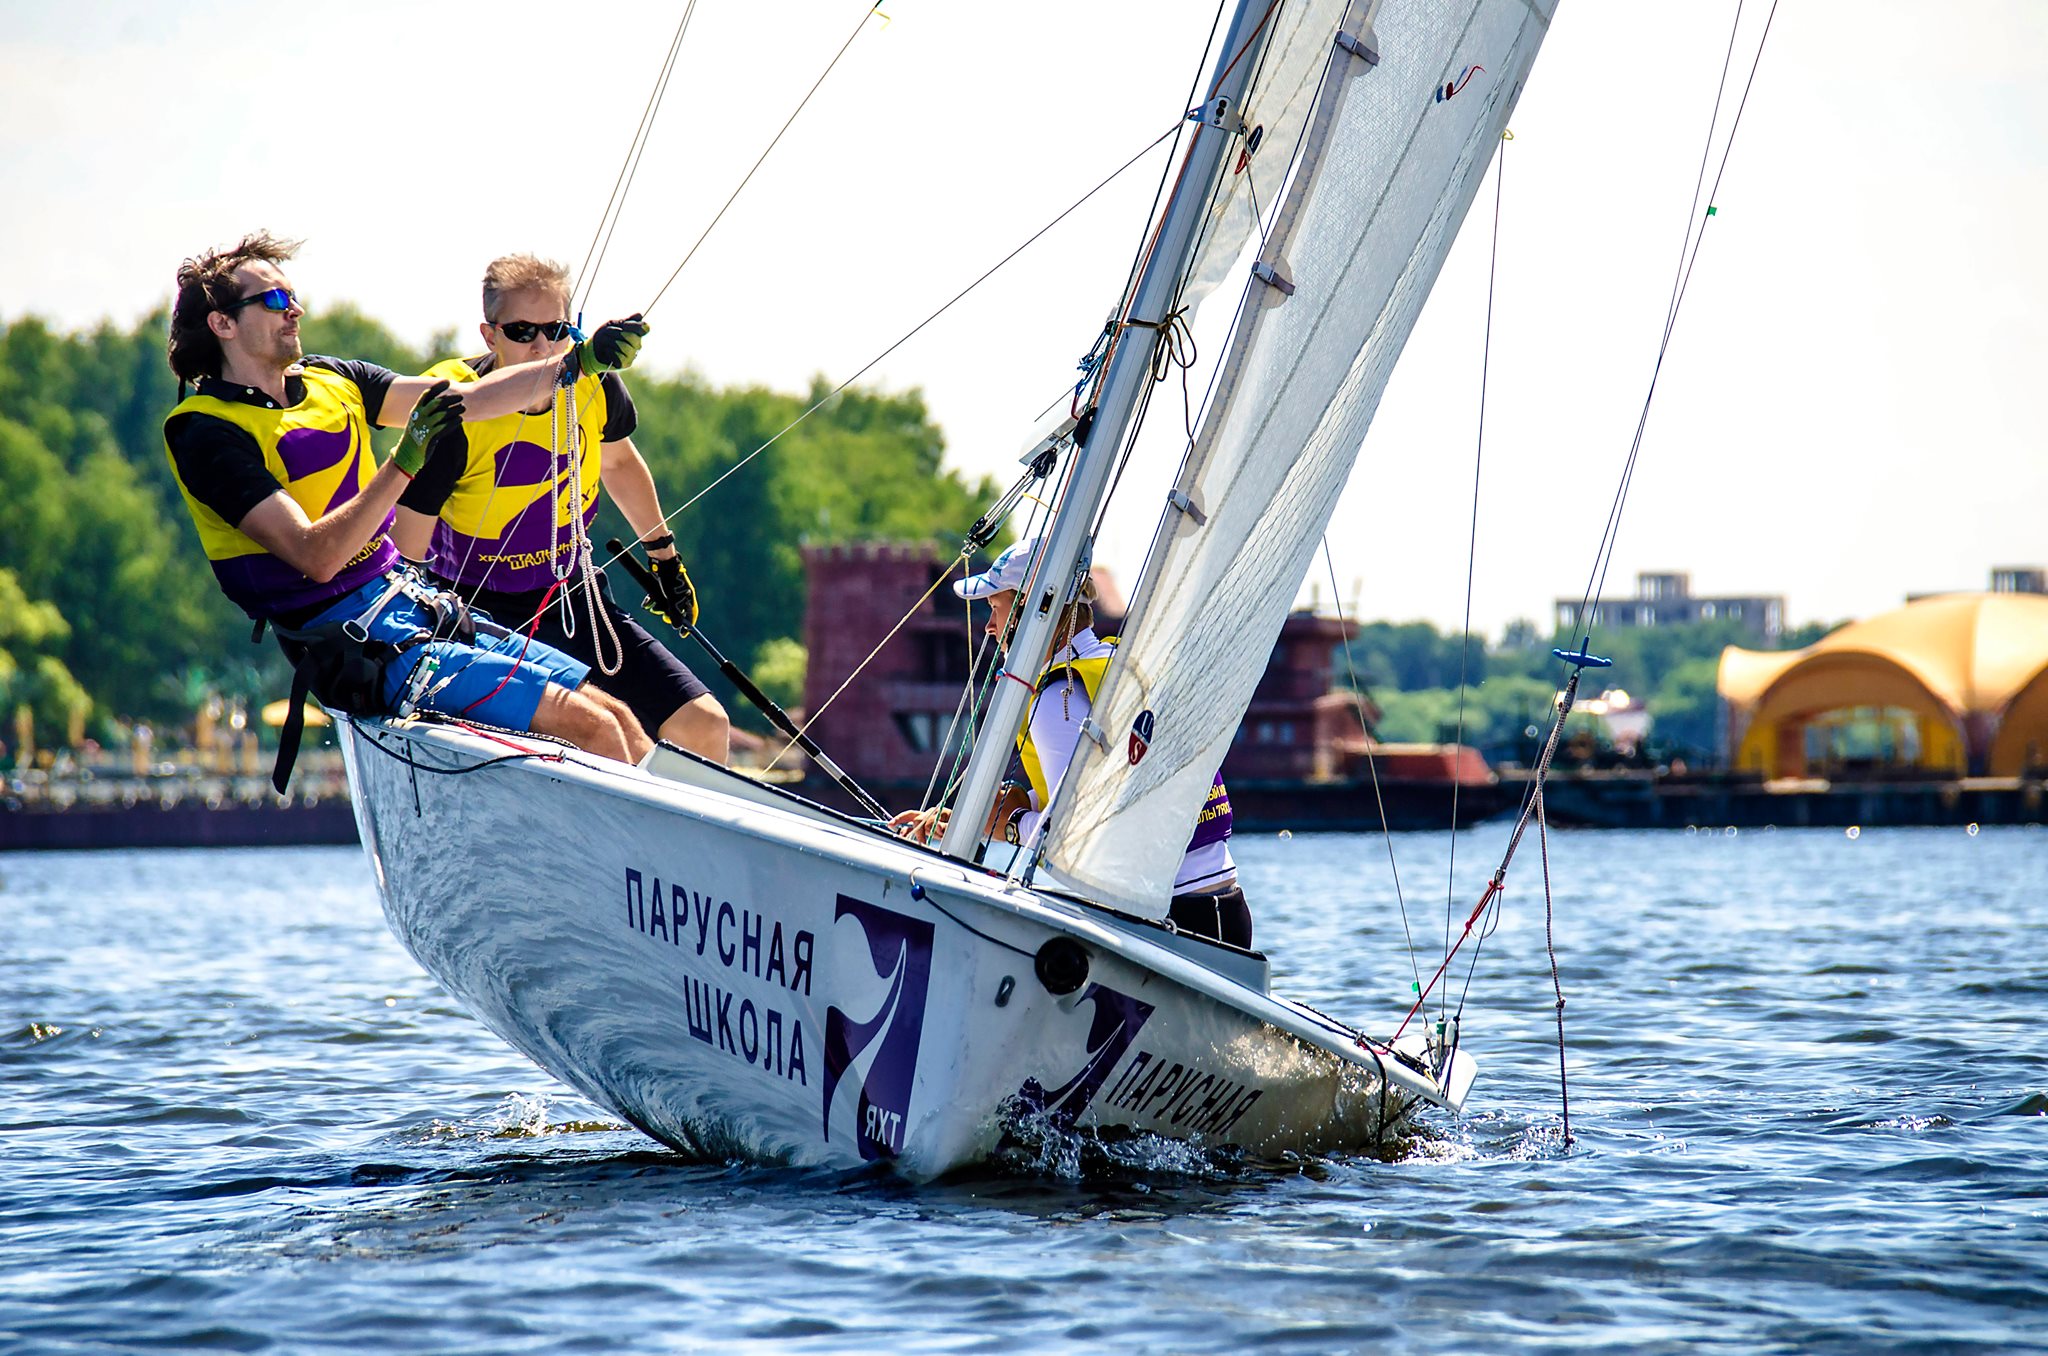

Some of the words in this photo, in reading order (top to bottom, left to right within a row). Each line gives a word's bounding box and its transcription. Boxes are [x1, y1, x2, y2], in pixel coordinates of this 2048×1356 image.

[626, 867, 815, 996] ПАРУСНАЯ
[683, 975, 807, 1087] ШКОЛА
[864, 1104, 902, 1148] ЯХТ
[1104, 1050, 1264, 1136] ПАРУСНАЯ
